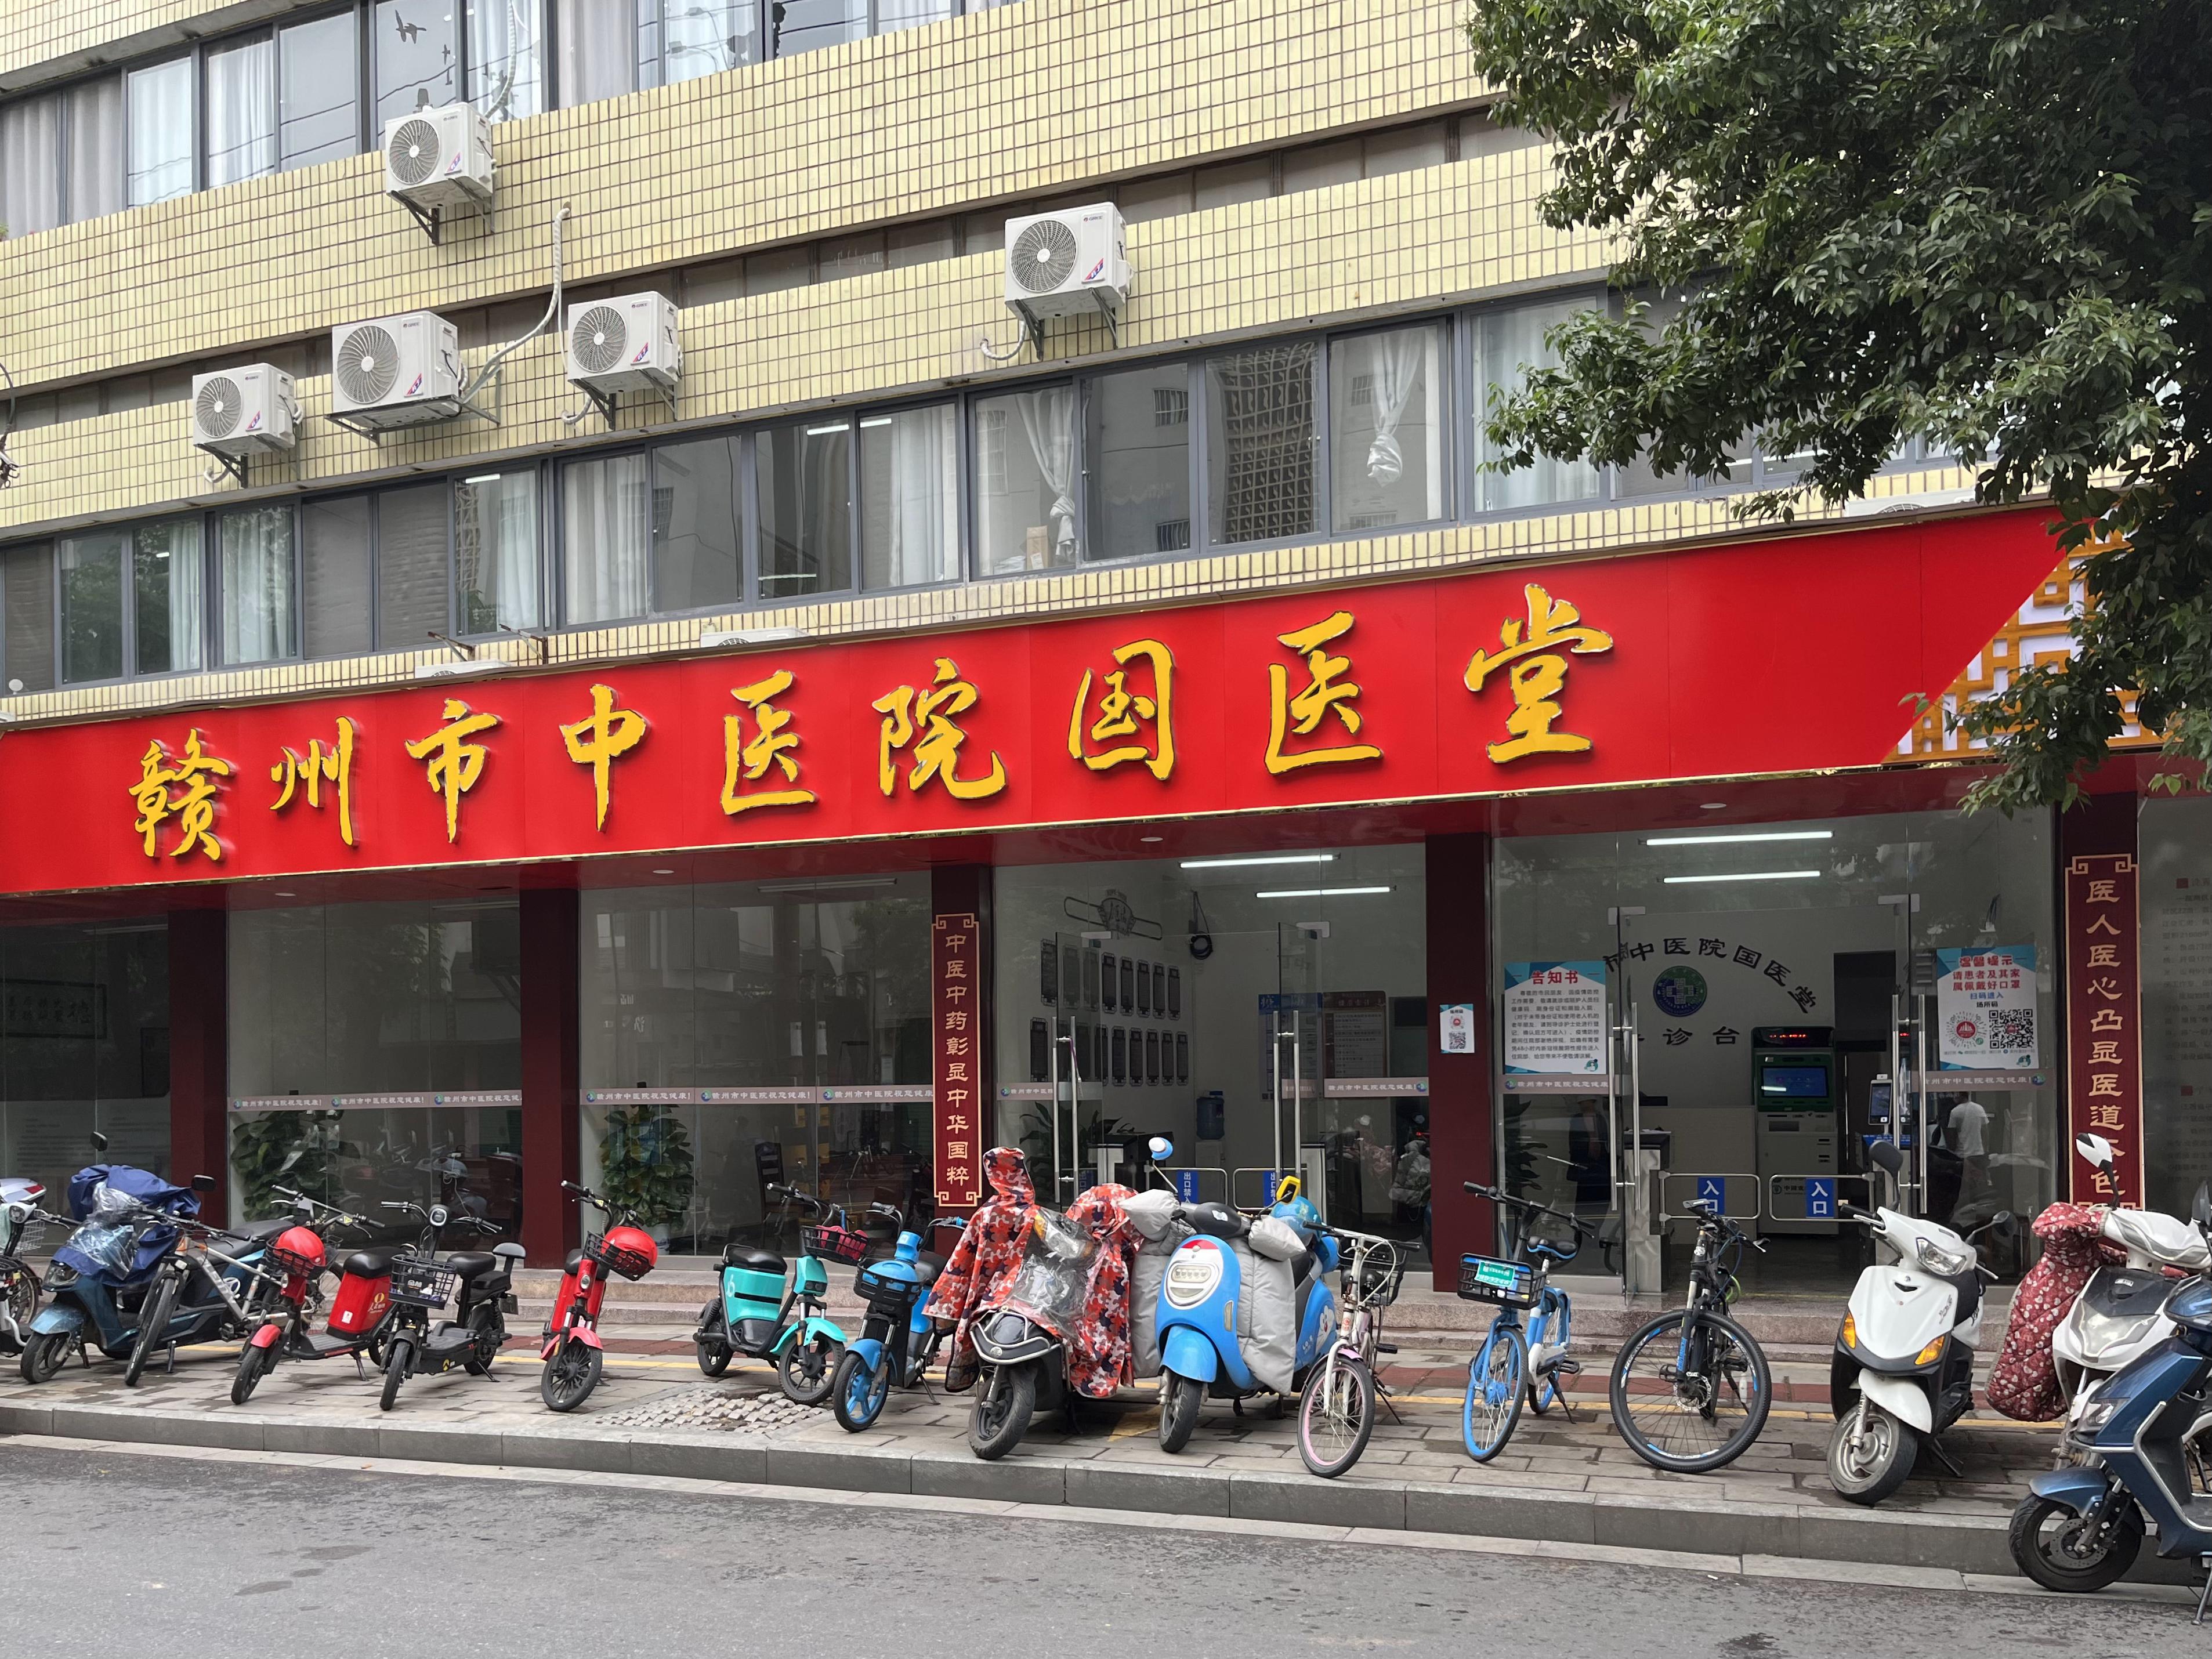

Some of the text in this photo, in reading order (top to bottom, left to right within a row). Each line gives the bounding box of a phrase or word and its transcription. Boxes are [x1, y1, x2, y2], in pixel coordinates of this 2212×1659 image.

[129, 584, 1612, 861] 赣州市中医院国医堂
[1959, 955, 2013, 968] 温馨提示
[1531, 970, 1579, 984] 告知书
[1953, 968, 2021, 980] 请患者及其家
[1953, 980, 2021, 991] 属佩戴好口罩
[945, 933, 970, 1186] 中医中药彰显中华国粹
[444, 1095, 522, 1103] 赣州市中医院祝您健
[1702, 1180, 1719, 1212] 入口
[1811, 1182, 1828, 1214] 入口
